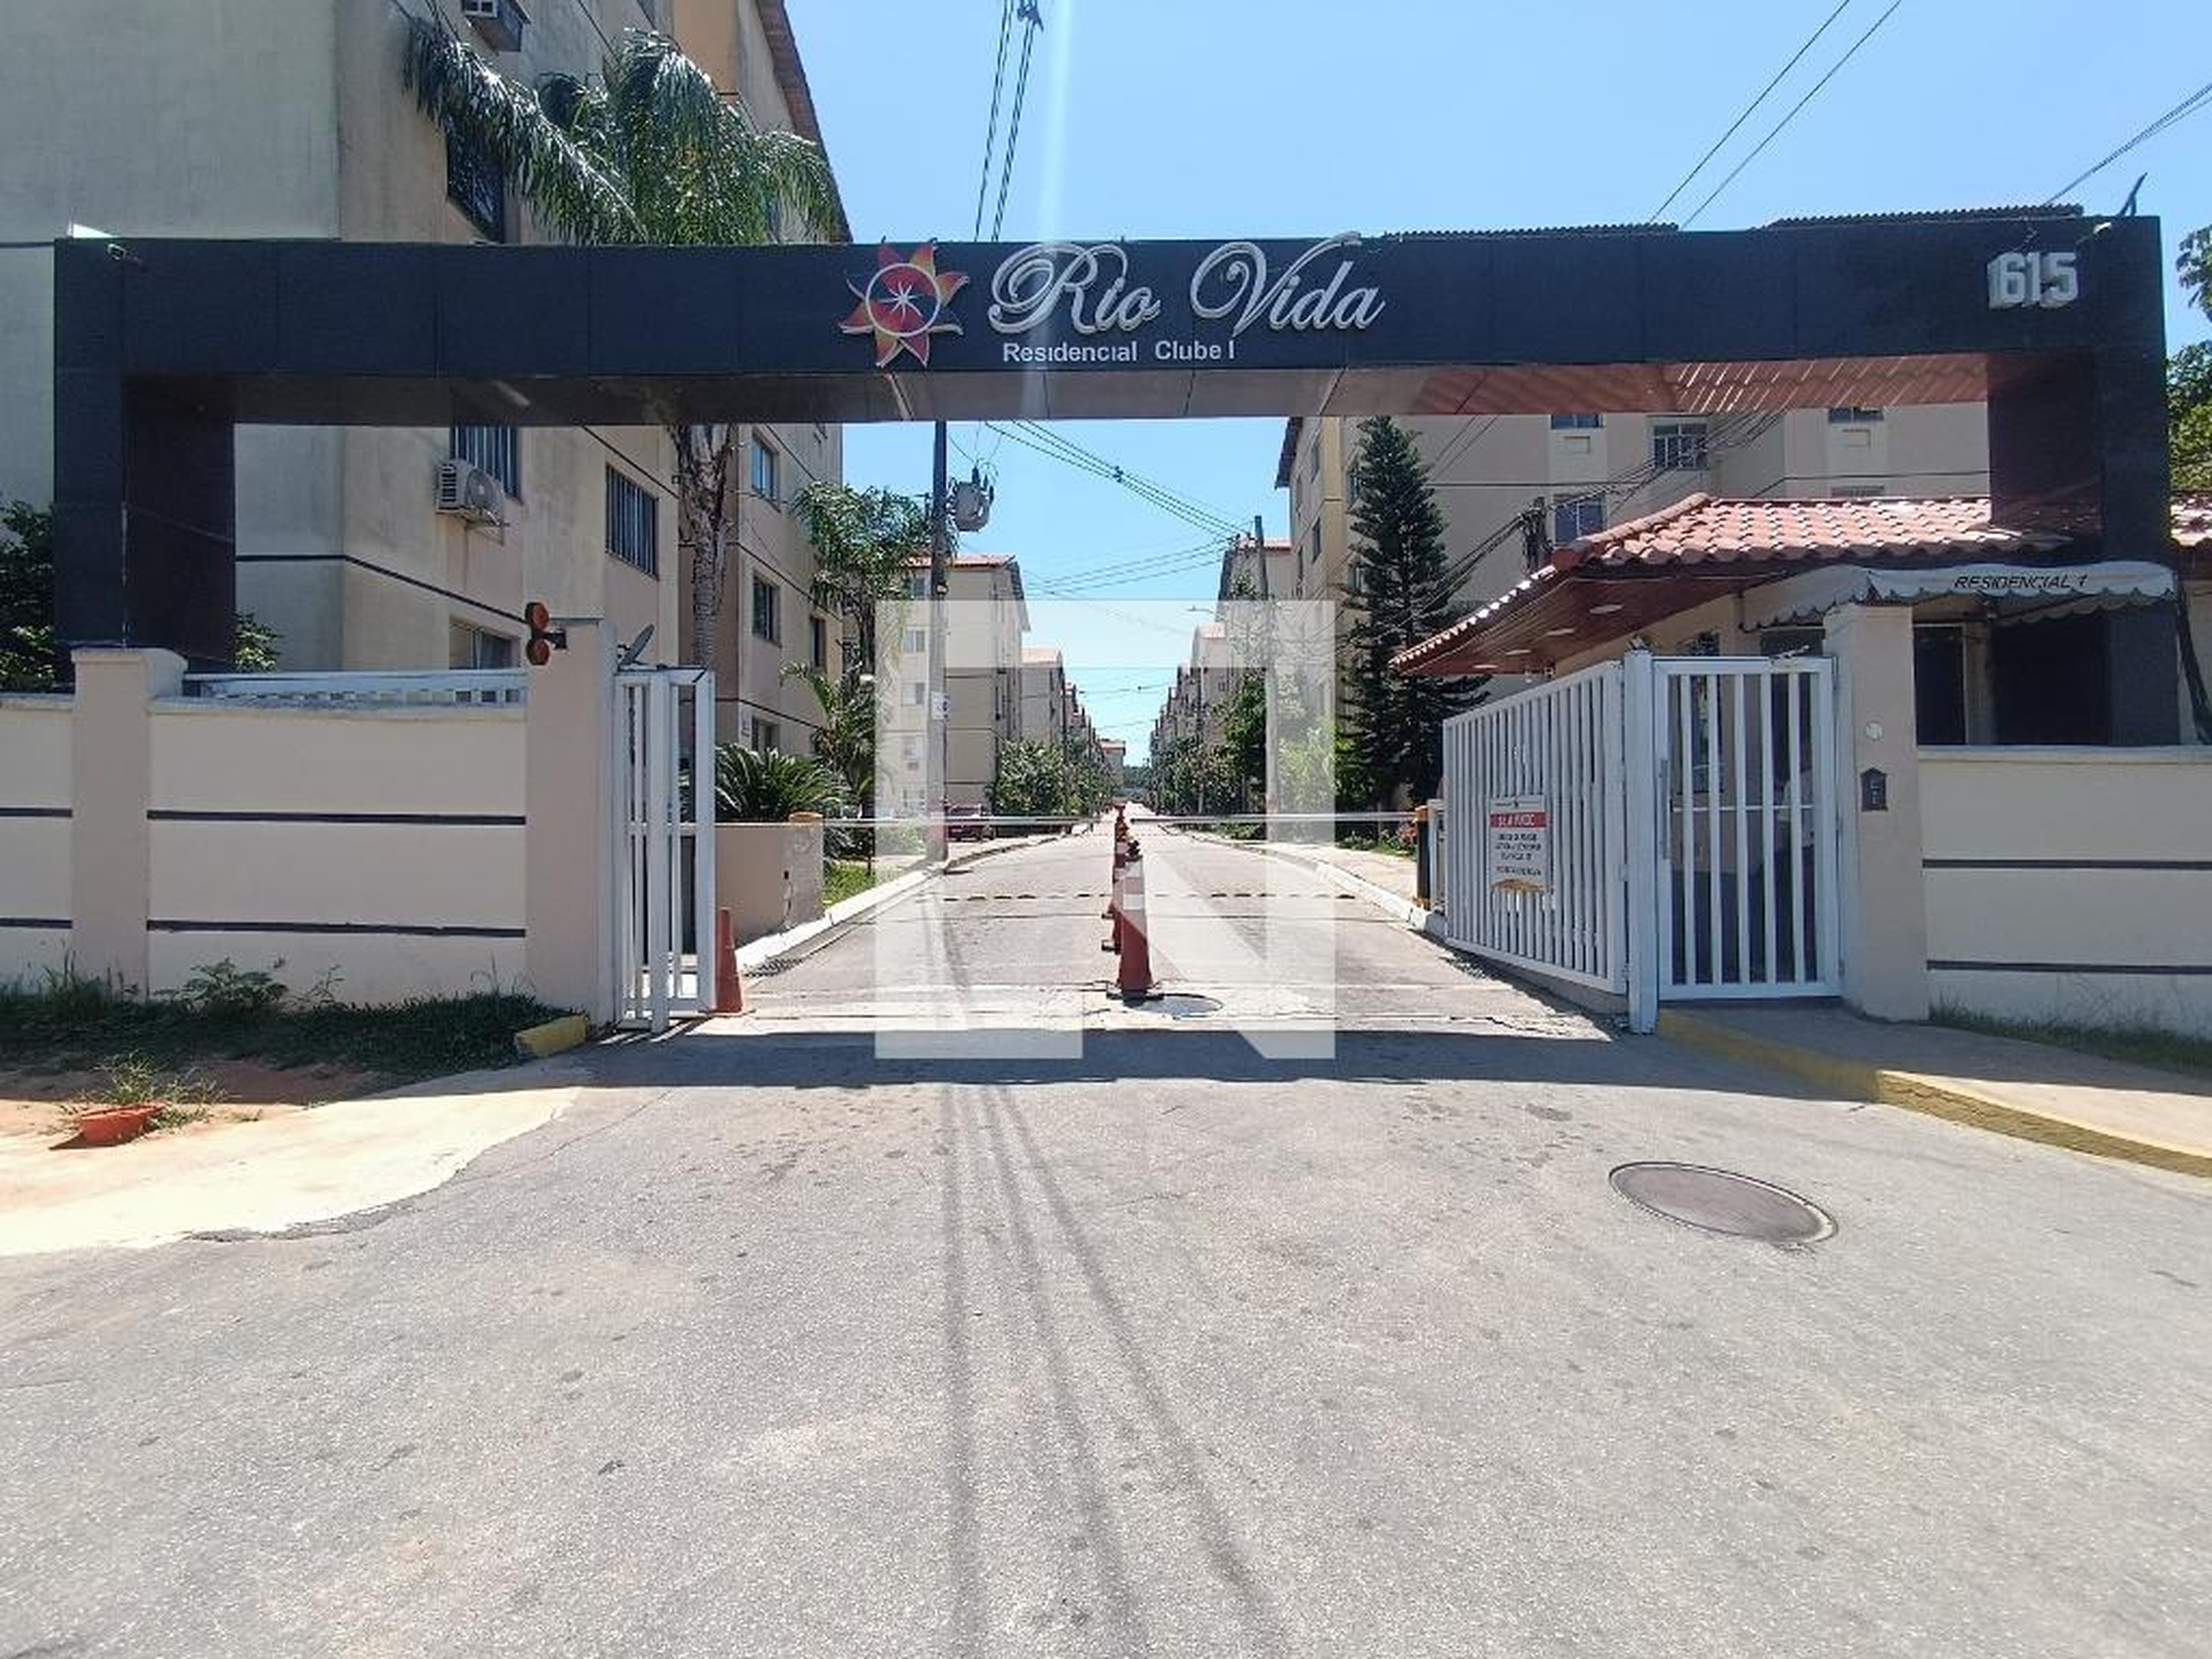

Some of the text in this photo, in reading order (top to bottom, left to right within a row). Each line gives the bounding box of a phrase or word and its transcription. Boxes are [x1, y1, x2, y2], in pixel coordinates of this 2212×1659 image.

[988, 230, 1386, 338] Rio Vida
[1987, 251, 2078, 309] 615
[1003, 341, 1137, 362] Residencial
[1154, 340, 1221, 361] Clube
[1954, 574, 2070, 589] RESIDENCIAL
